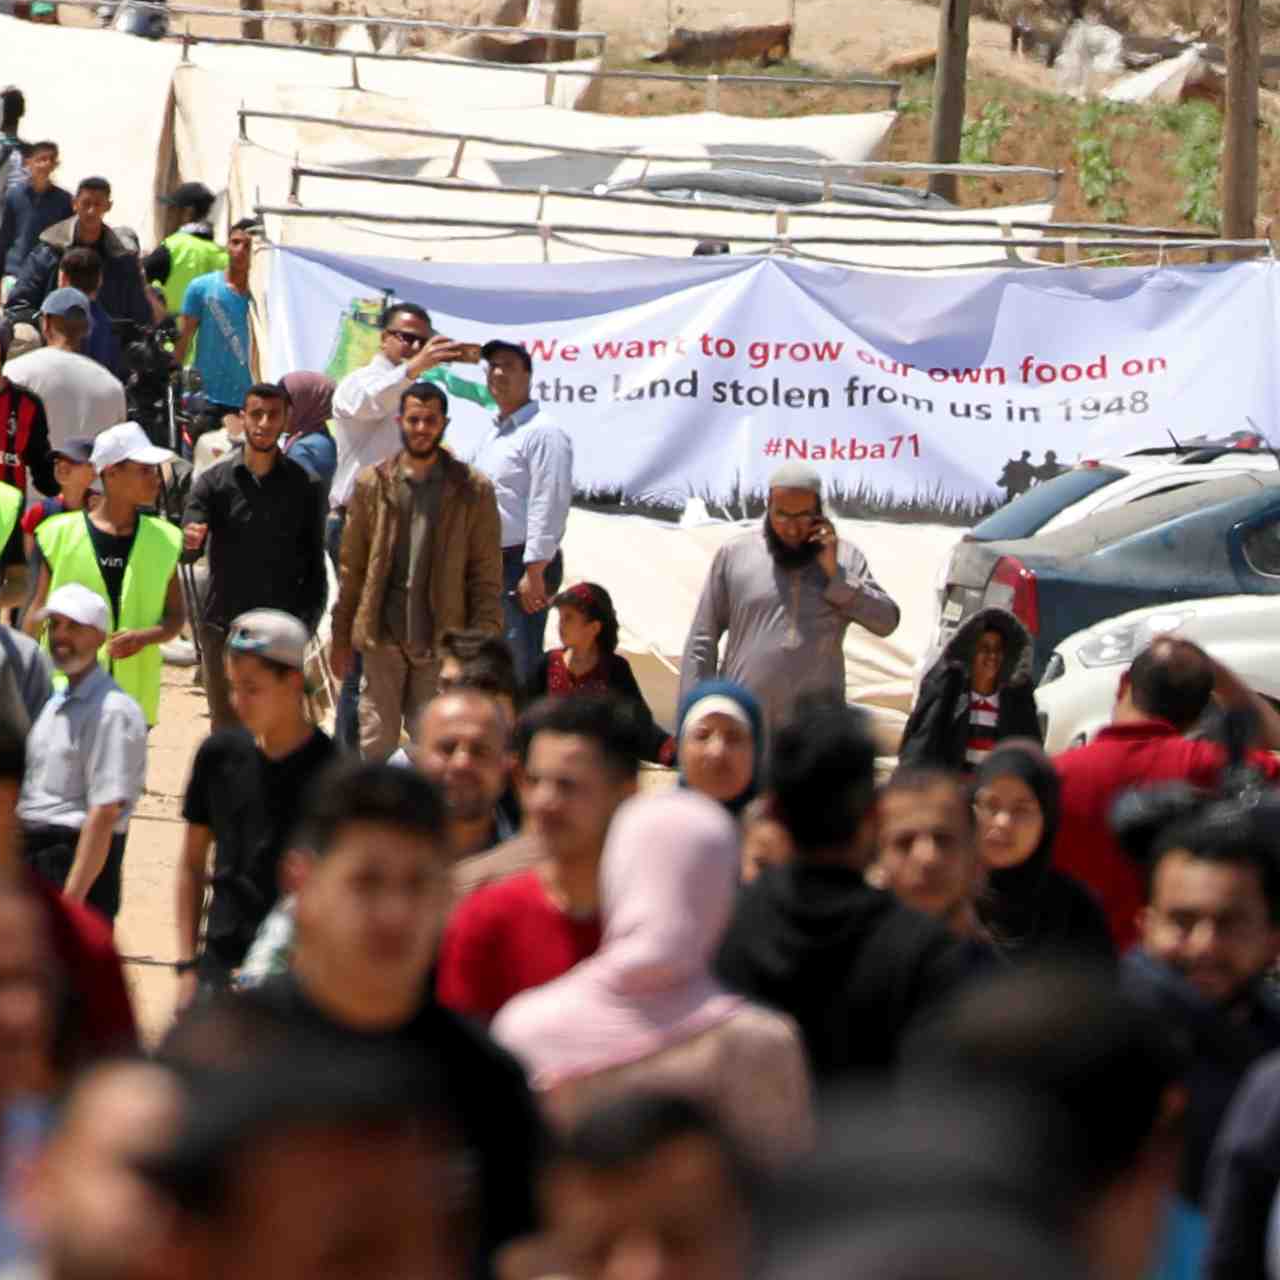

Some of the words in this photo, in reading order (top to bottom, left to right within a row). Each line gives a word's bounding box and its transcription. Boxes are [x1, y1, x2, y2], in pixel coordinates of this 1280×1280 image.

[520, 337, 579, 362] We
[699, 333, 736, 358] to
[748, 340, 844, 369] grow
[856, 348, 915, 377] our
[927, 365, 1006, 385] own
[1019, 354, 1108, 385] food
[1121, 355, 1168, 377] on
[538, 377, 598, 404] the
[712, 377, 830, 409] stolen
[843, 375, 934, 414] from
[950, 398, 993, 421] us
[1006, 399, 1041, 423] in
[1058, 390, 1151, 422] 1948
[764, 433, 922, 461] #Nakba71
